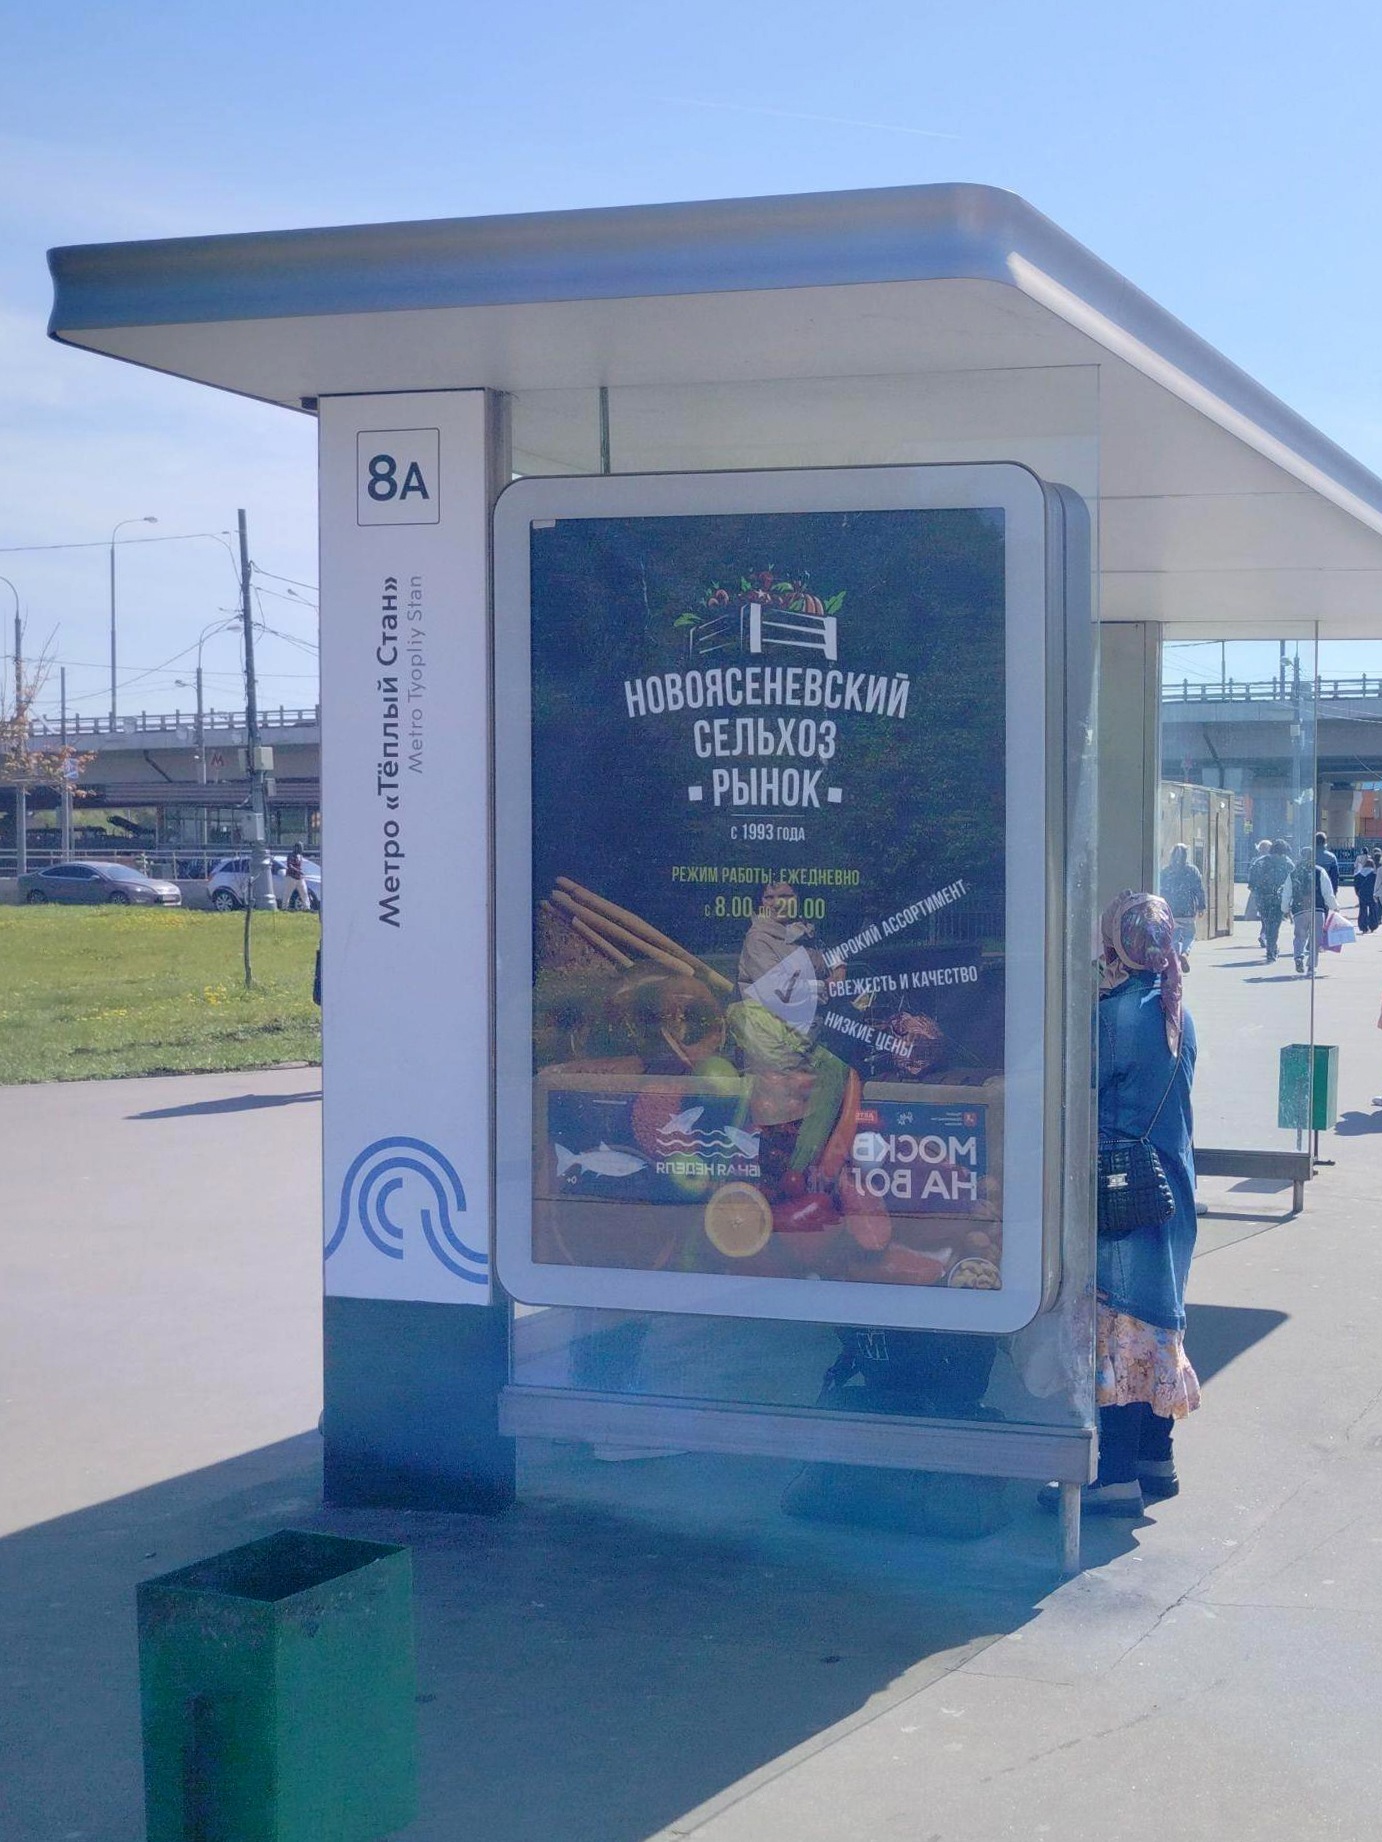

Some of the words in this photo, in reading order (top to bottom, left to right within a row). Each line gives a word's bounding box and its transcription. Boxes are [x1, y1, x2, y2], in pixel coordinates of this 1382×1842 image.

[376, 576, 399, 667] Стан»
[407, 576, 423, 622] Stan
[408, 628, 428, 705] Tyopliy
[624, 667, 911, 719] НОВОЯСЕНЕВСКИЙ
[377, 678, 399, 809] «Тёплый
[408, 708, 424, 774] Metro
[694, 718, 837, 759] СЕЛЬХОЗ
[713, 768, 821, 808] РЫНОК
[742, 824, 774, 840] 1993
[379, 813, 405, 928] Метро
[672, 866, 718, 882] РЕЖИМ
[722, 867, 776, 884] РАБОТЫ:
[780, 868, 860, 886] ЕЖЕДНЕВНО
[715, 896, 752, 917] 8.00
[776, 898, 826, 919] 20.00
[821, 924, 883, 968] ШИРОКИЙ
[881, 879, 968, 937] АССОРТИМЕНТ
[828, 975, 897, 998] СВЕЖЕСТЬ
[899, 973, 909, 990] И
[912, 966, 978, 989] КАЧЕСТВО
[824, 1011, 876, 1044] НИЗКИЕ
[874, 1031, 914, 1058] ЦЕНЫ
